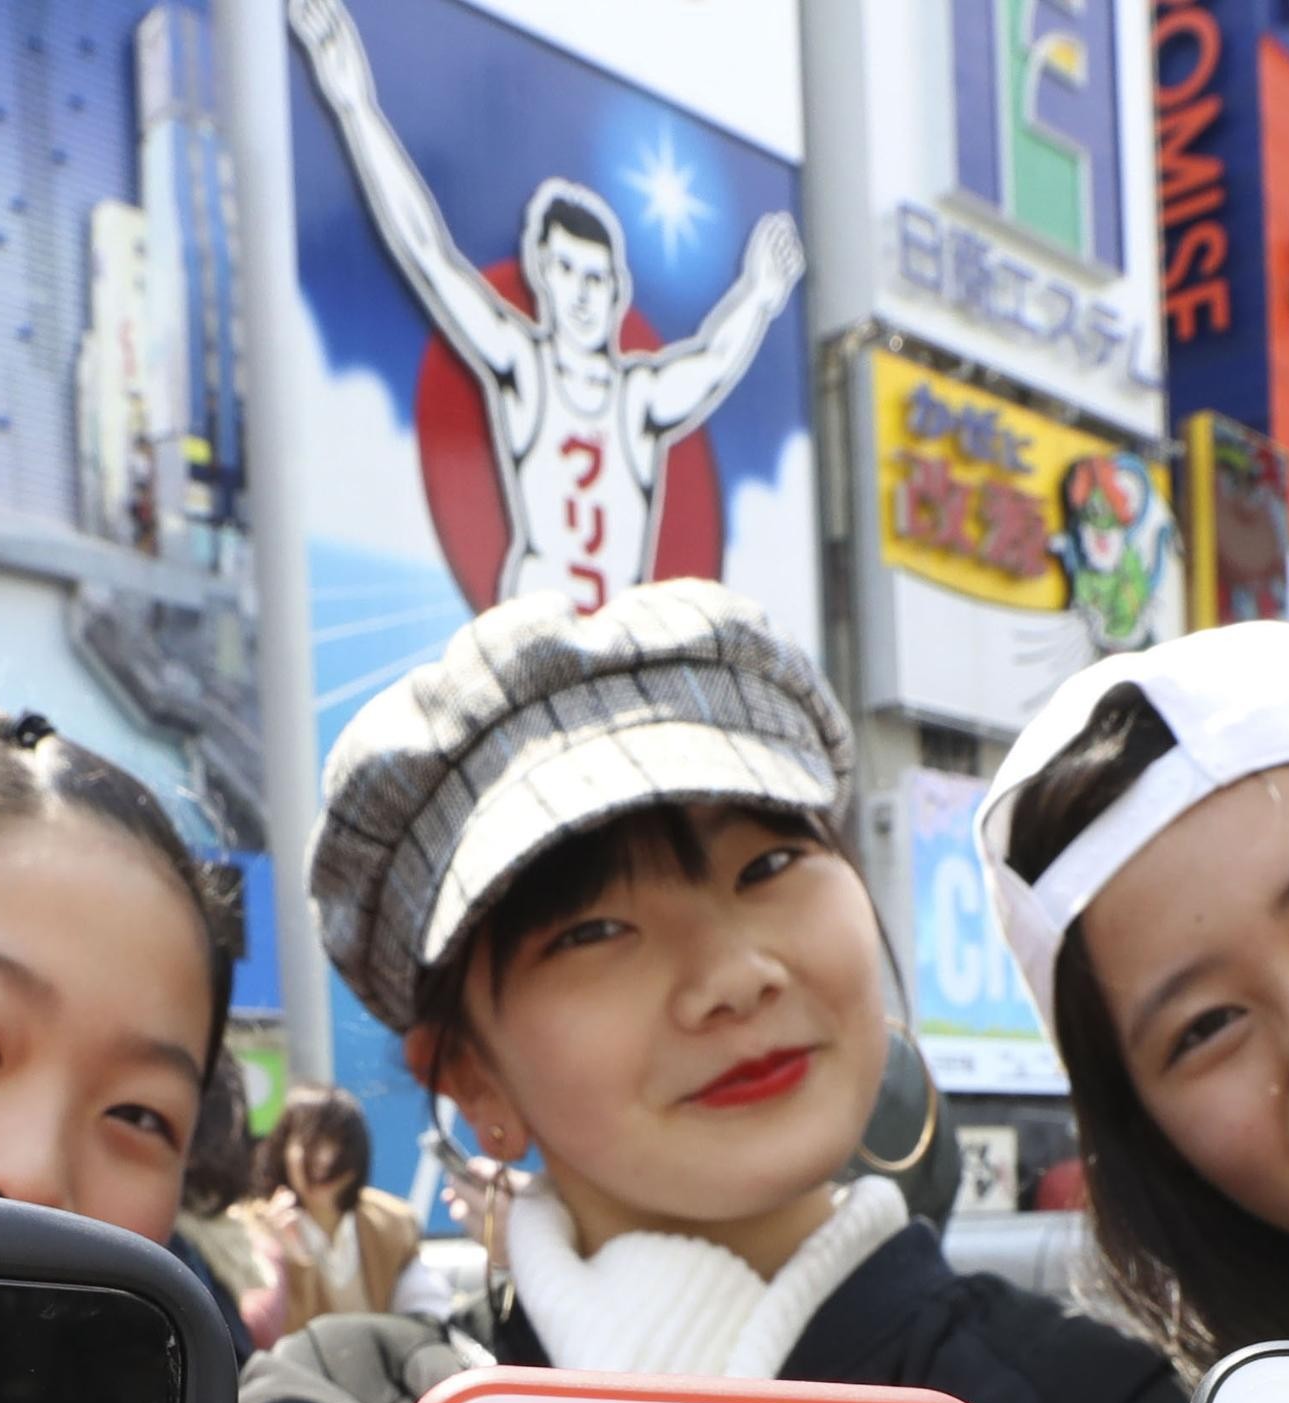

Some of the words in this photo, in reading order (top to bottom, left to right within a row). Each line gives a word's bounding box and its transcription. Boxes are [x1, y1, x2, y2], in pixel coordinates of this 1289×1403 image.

[1153, 0, 1231, 343] OMISE
[558, 427, 609, 618] グリコ
